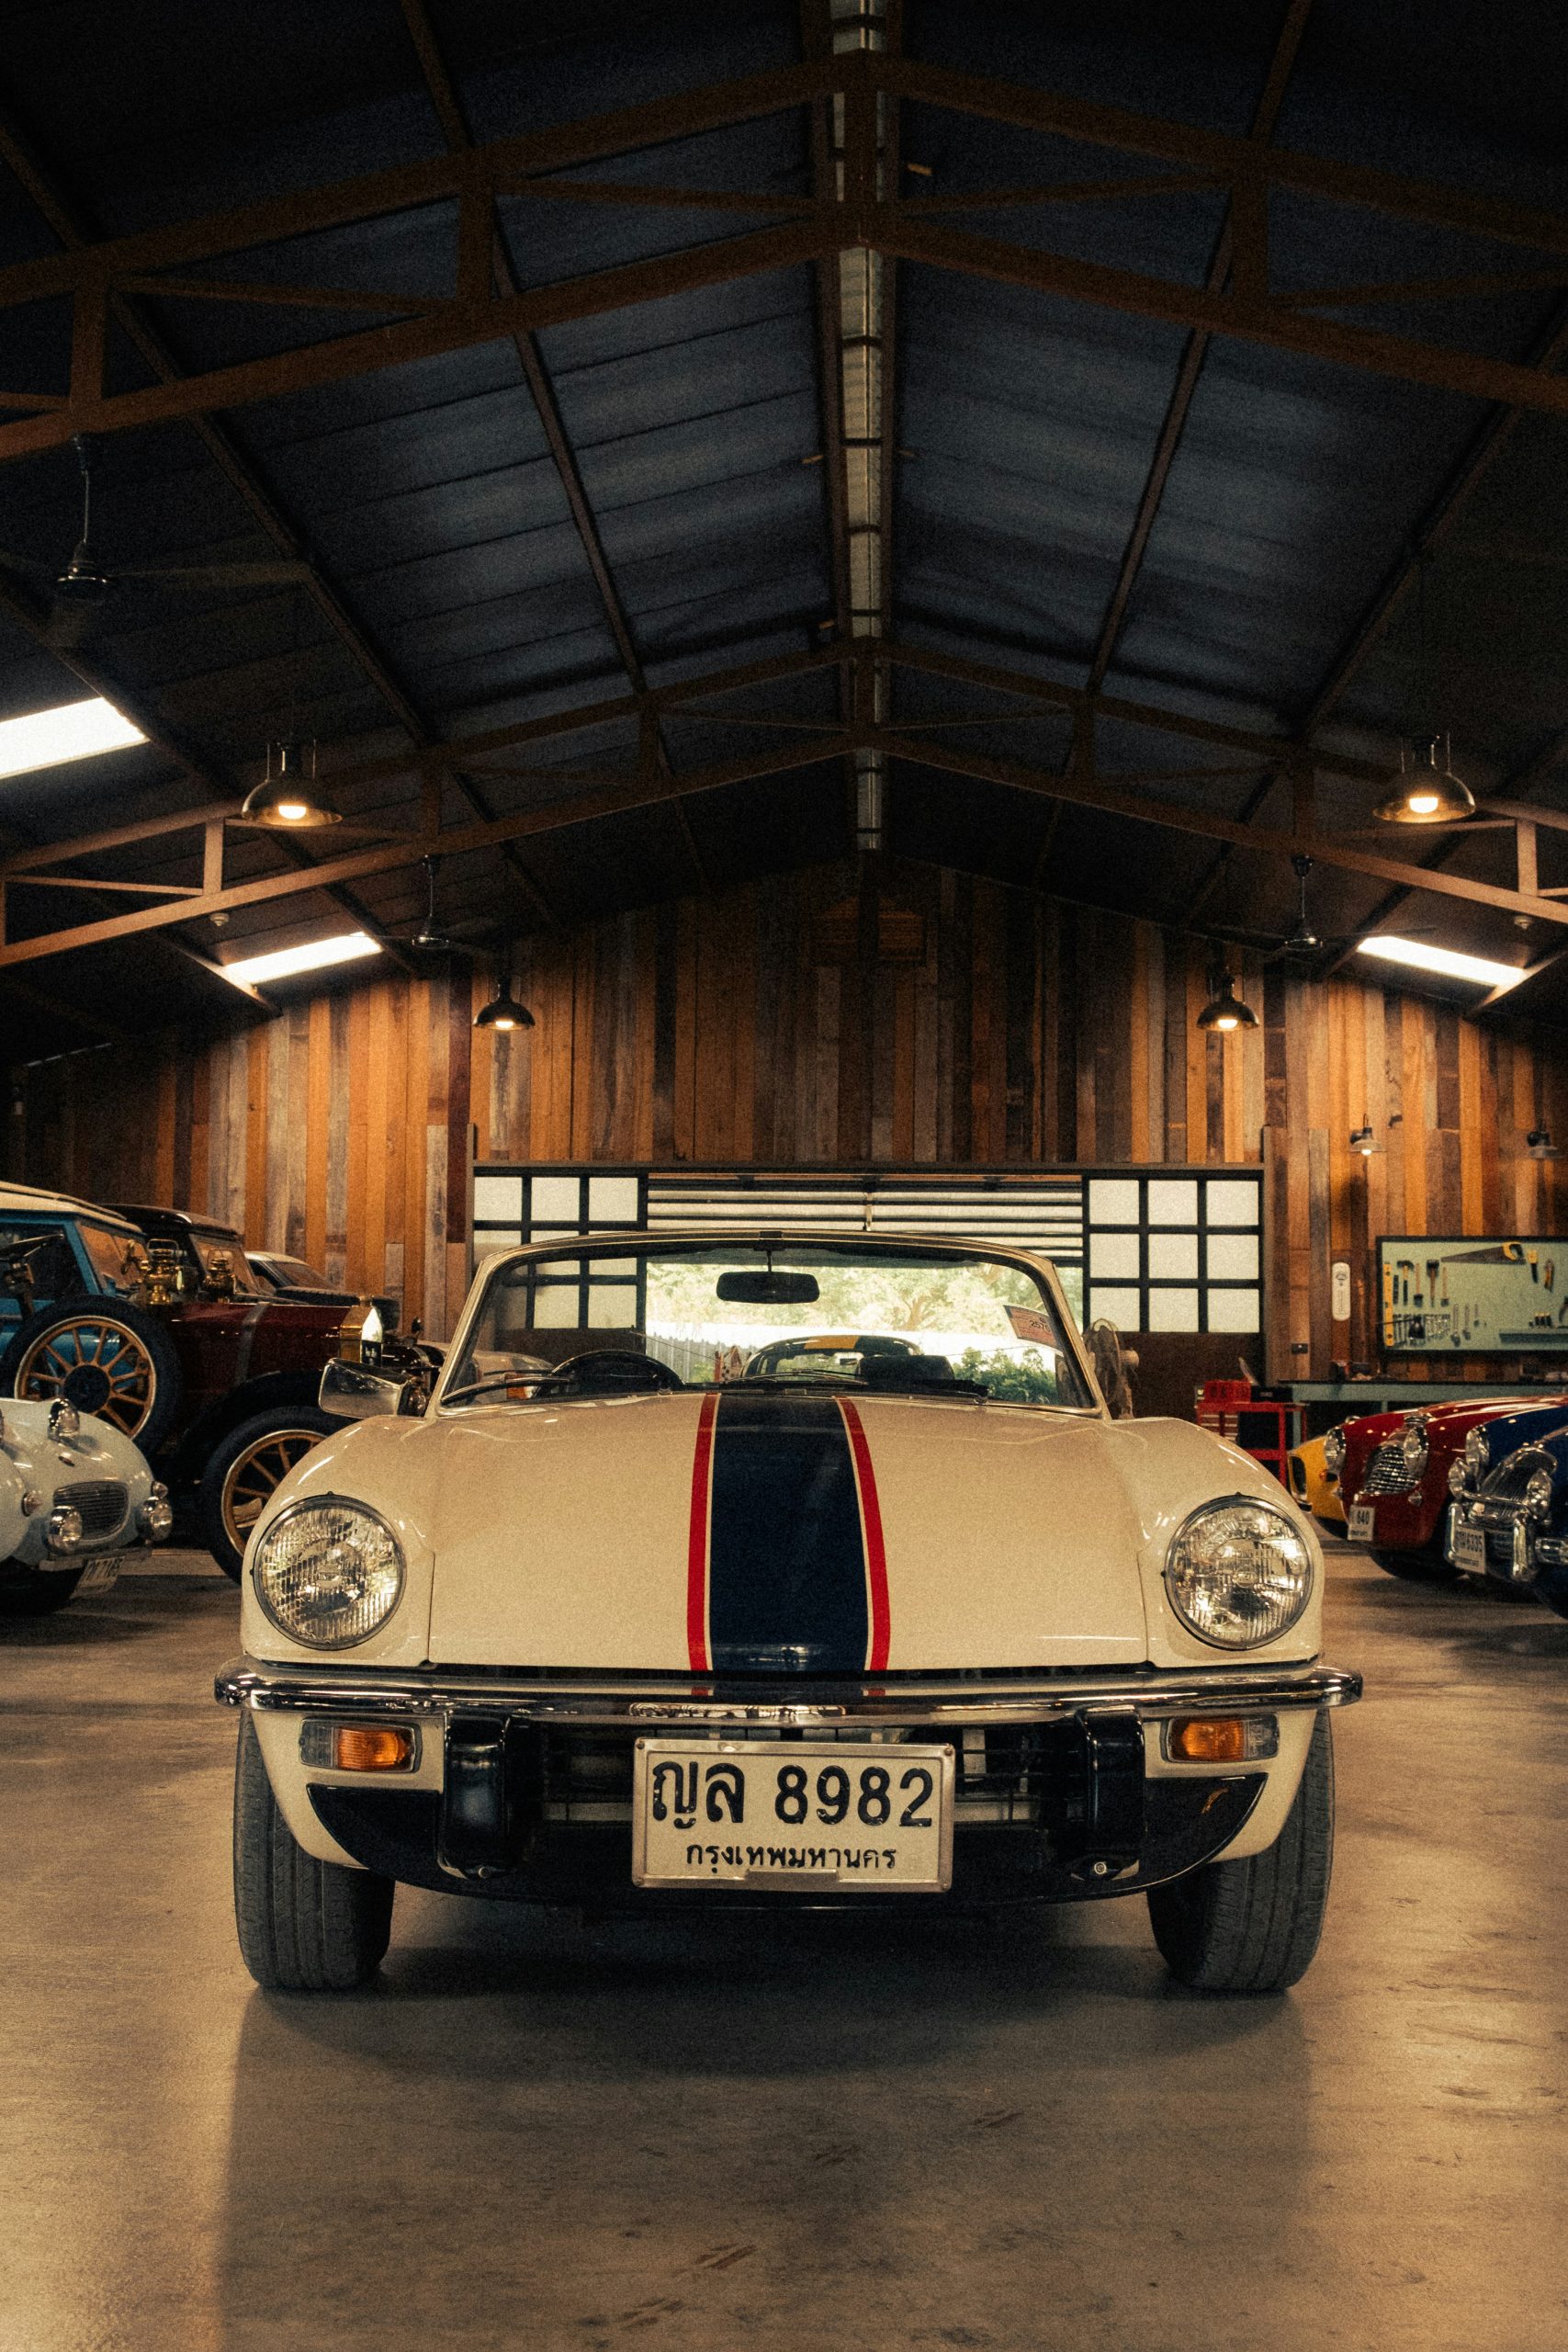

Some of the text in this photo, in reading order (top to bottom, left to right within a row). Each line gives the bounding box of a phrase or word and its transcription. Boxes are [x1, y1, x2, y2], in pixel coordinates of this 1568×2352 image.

[652, 1761, 933, 1829] ญล 8982
[686, 1844, 897, 1874] กรุงเทพมหานคร
